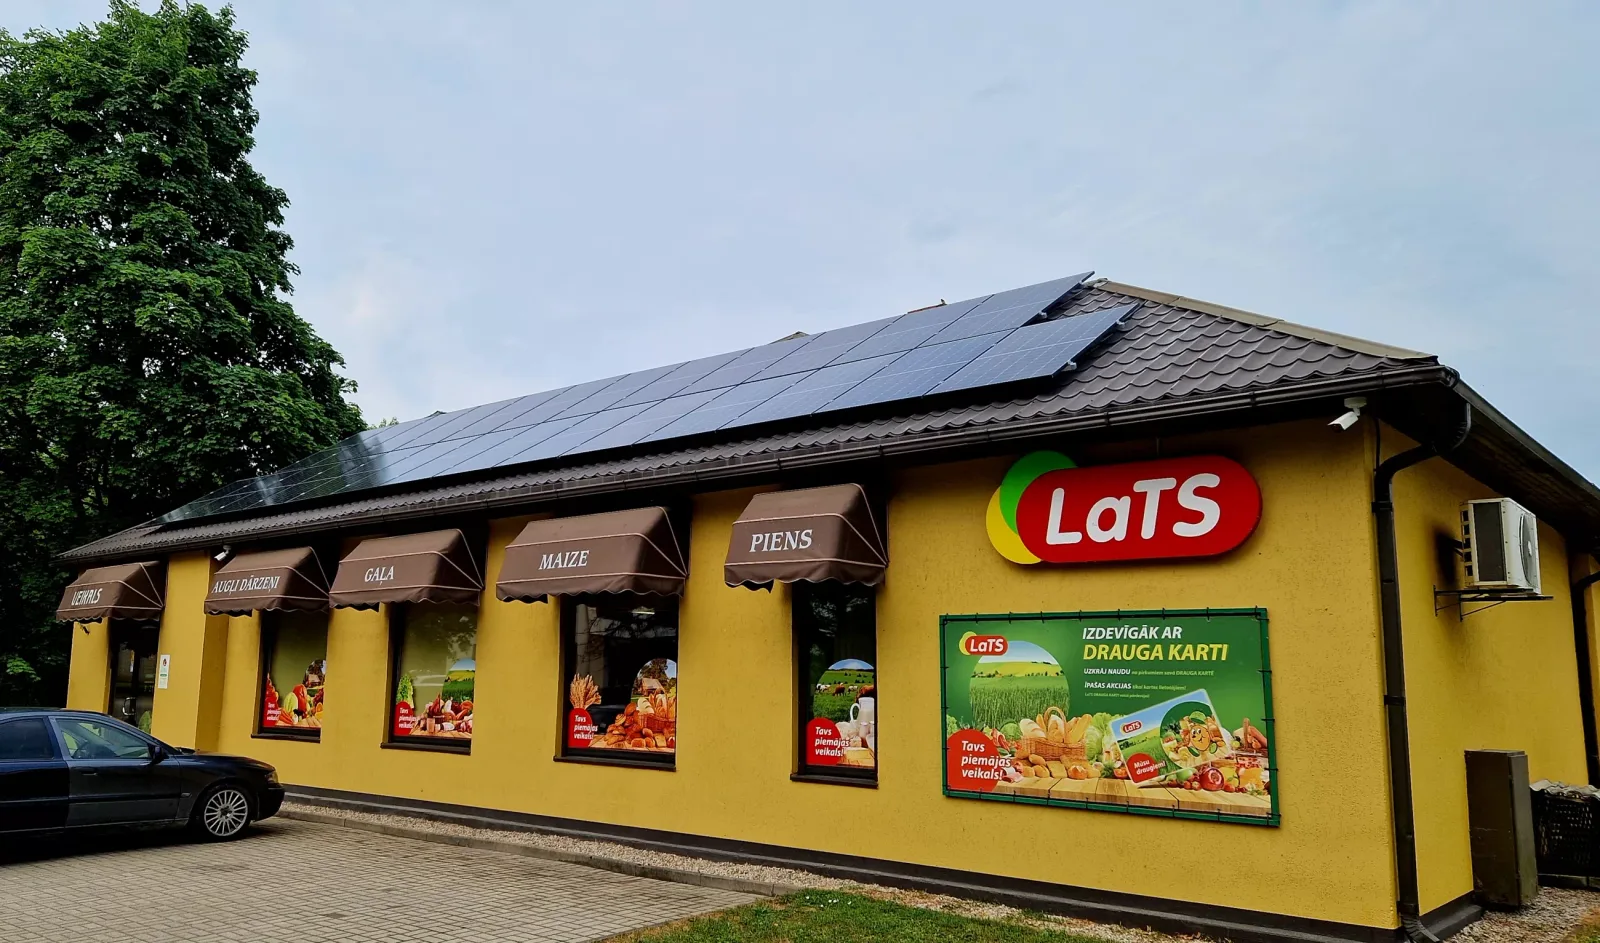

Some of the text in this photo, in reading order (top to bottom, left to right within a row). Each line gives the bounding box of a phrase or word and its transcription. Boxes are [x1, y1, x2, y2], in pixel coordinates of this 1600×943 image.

[1045, 472, 1221, 545] LaTS
[748, 529, 813, 552] PIENS
[538, 549, 590, 570] MAIZE
[364, 565, 394, 586] GAĻA
[211, 574, 281, 596] AUGĻI DĀRZEŅI
[71, 588, 103, 606] VEIKALS
[1082, 624, 1183, 640] IZDEVĪGĀK AR
[970, 638, 1004, 653] LaTS
[1083, 643, 1229, 661] DRAUGA KARTI
[1083, 667, 1108, 675] UZKRĀJ
[1084, 680, 1106, 689] ĪPAŠAS
[1106, 682, 1132, 690] AKCIJAS
[815, 726, 832, 736] Tavs
[1123, 721, 1141, 733] LaTS
[814, 736, 850, 748] piemājas
[961, 740, 985, 752] Tavs
[815, 747, 845, 757] veikals!
[961, 753, 1011, 769] piemājas
[1133, 759, 1150, 769] Mūsu
[1136, 760, 1166, 775] draugiem!
[961, 768, 1004, 780] veikals!
